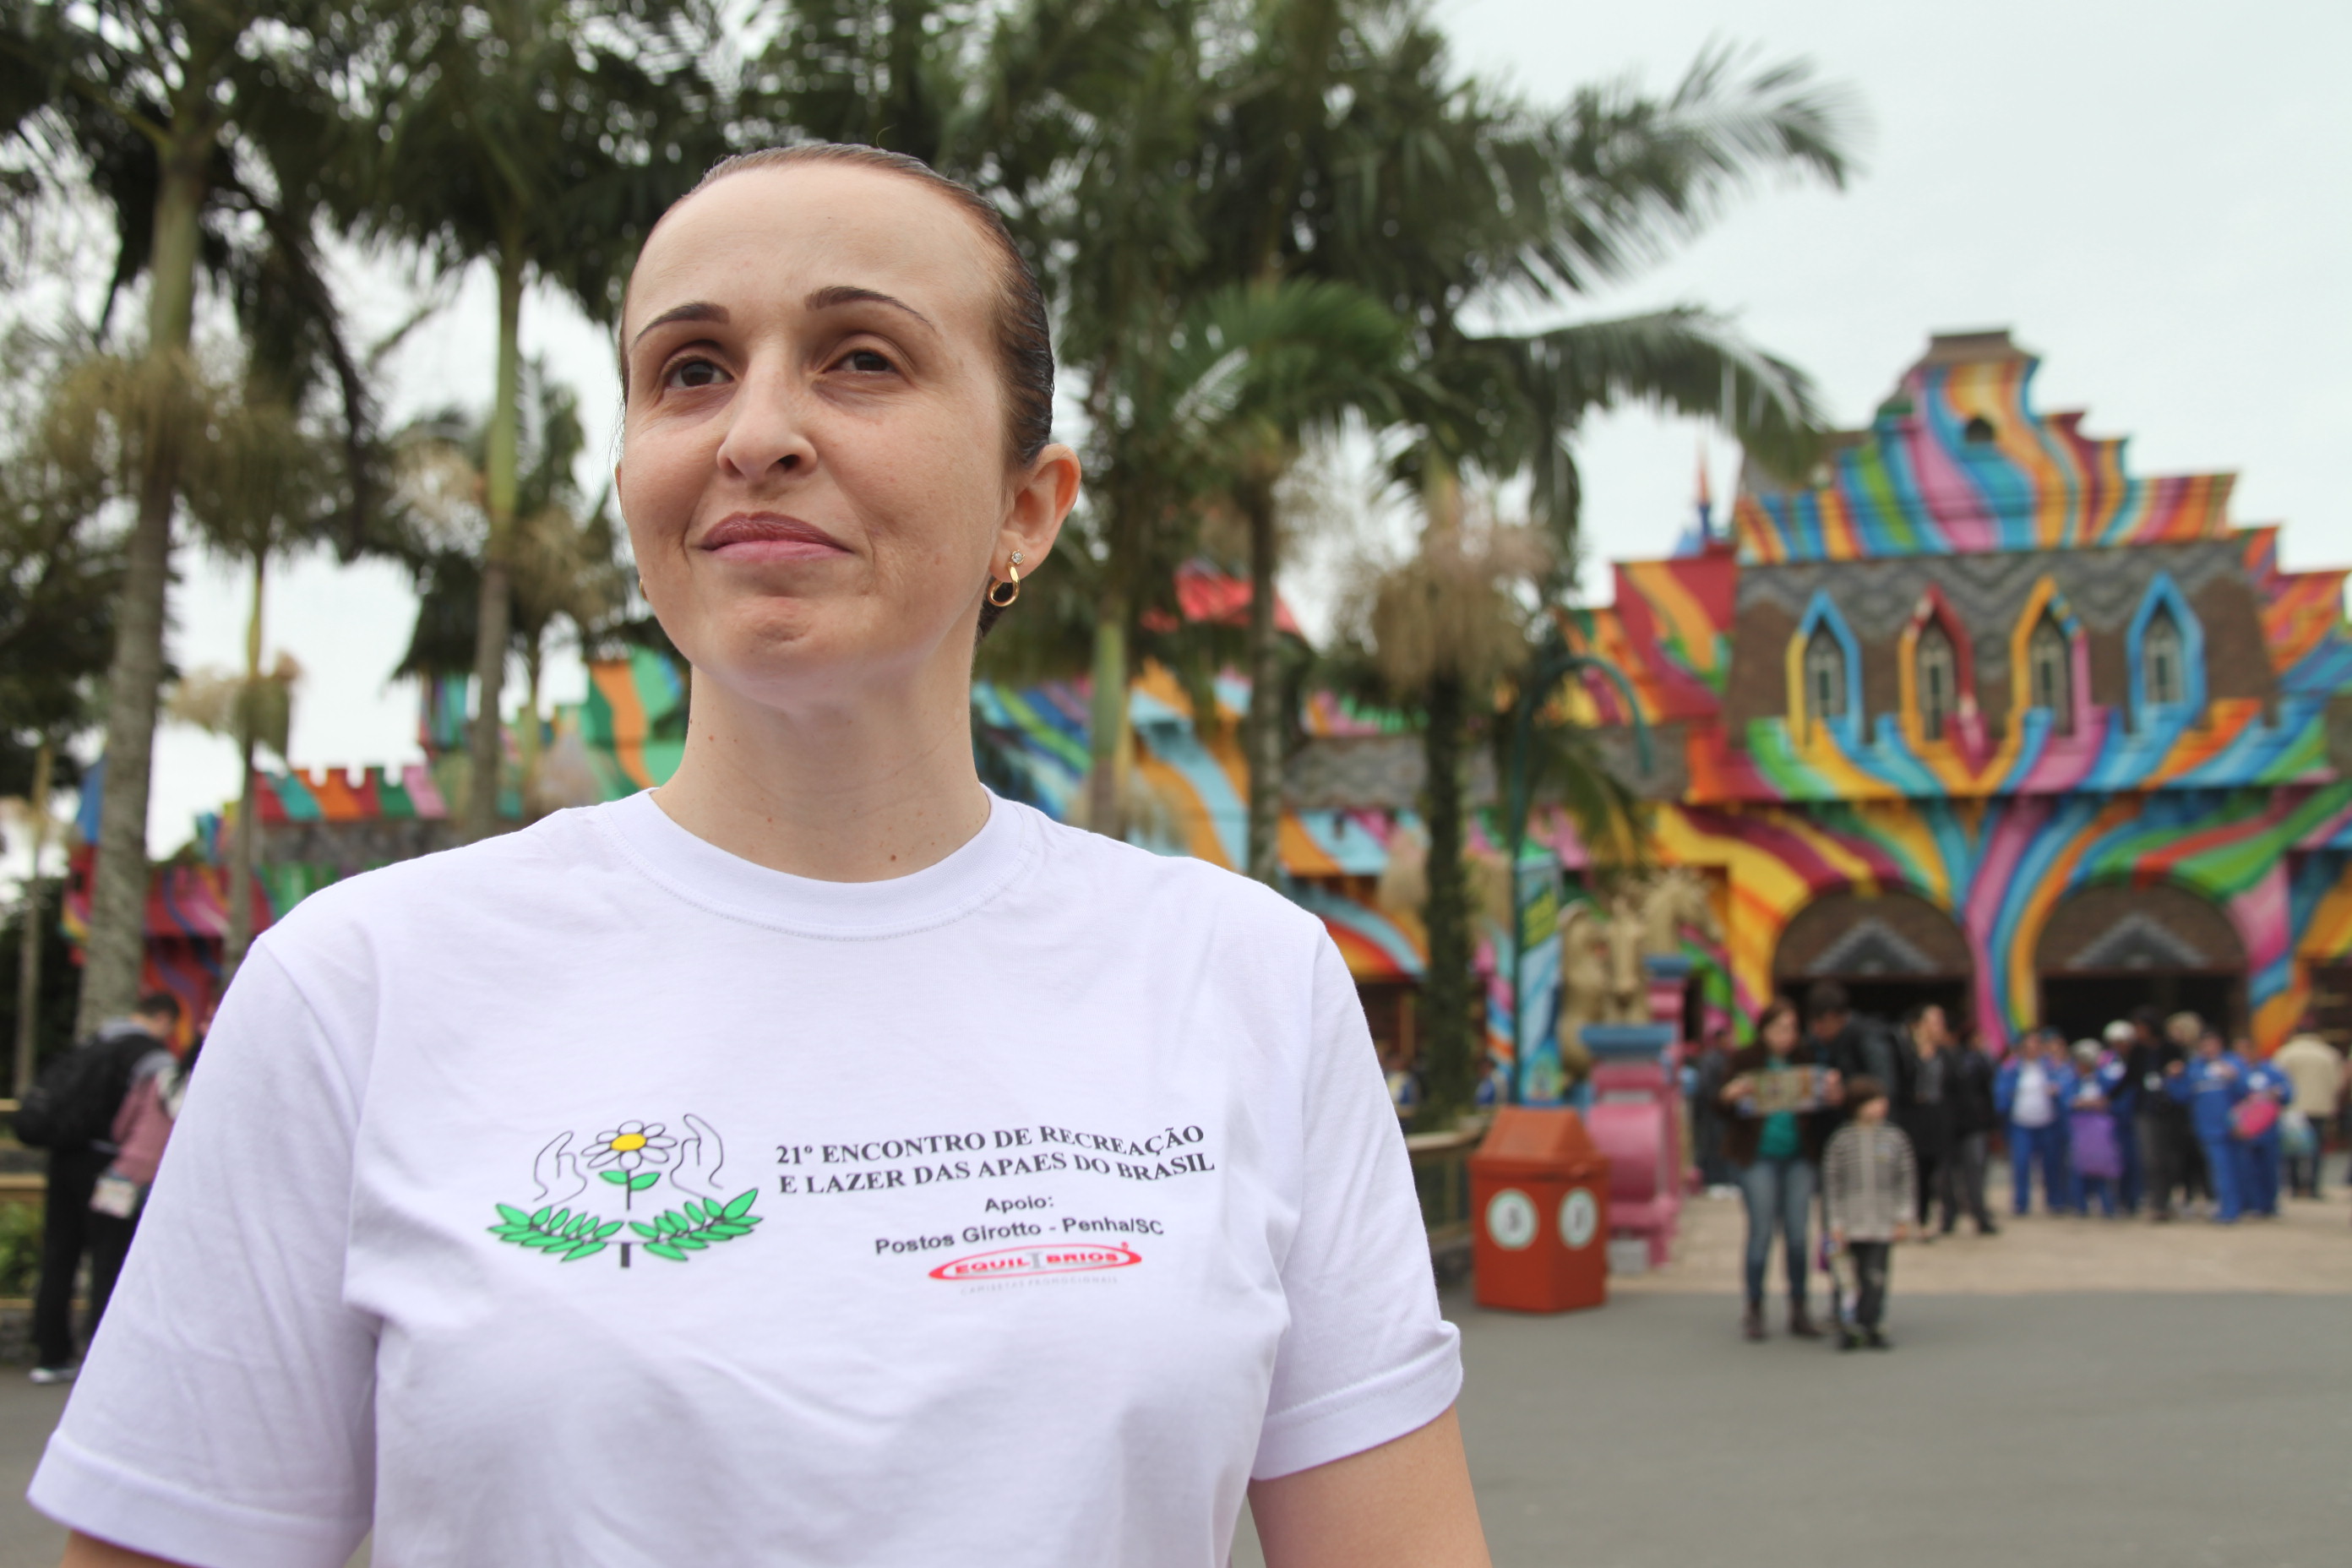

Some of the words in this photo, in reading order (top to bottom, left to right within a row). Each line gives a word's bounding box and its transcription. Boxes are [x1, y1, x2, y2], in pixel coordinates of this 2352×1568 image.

[821, 1131, 987, 1163] ENCONTRO
[993, 1128, 1032, 1149] DE
[1038, 1125, 1205, 1156] RECREAÇÃO
[779, 1175, 798, 1194] E
[806, 1169, 907, 1194] LAZER
[913, 1161, 971, 1185] DAS
[977, 1152, 1068, 1179] APAES
[1072, 1153, 1111, 1174] DO
[1115, 1152, 1215, 1181] BRASIL
[984, 1195, 1055, 1214] Apoio:
[874, 1233, 956, 1255] Postos
[961, 1222, 1043, 1244] Girotto
[1061, 1216, 1164, 1237] Penha/SC
